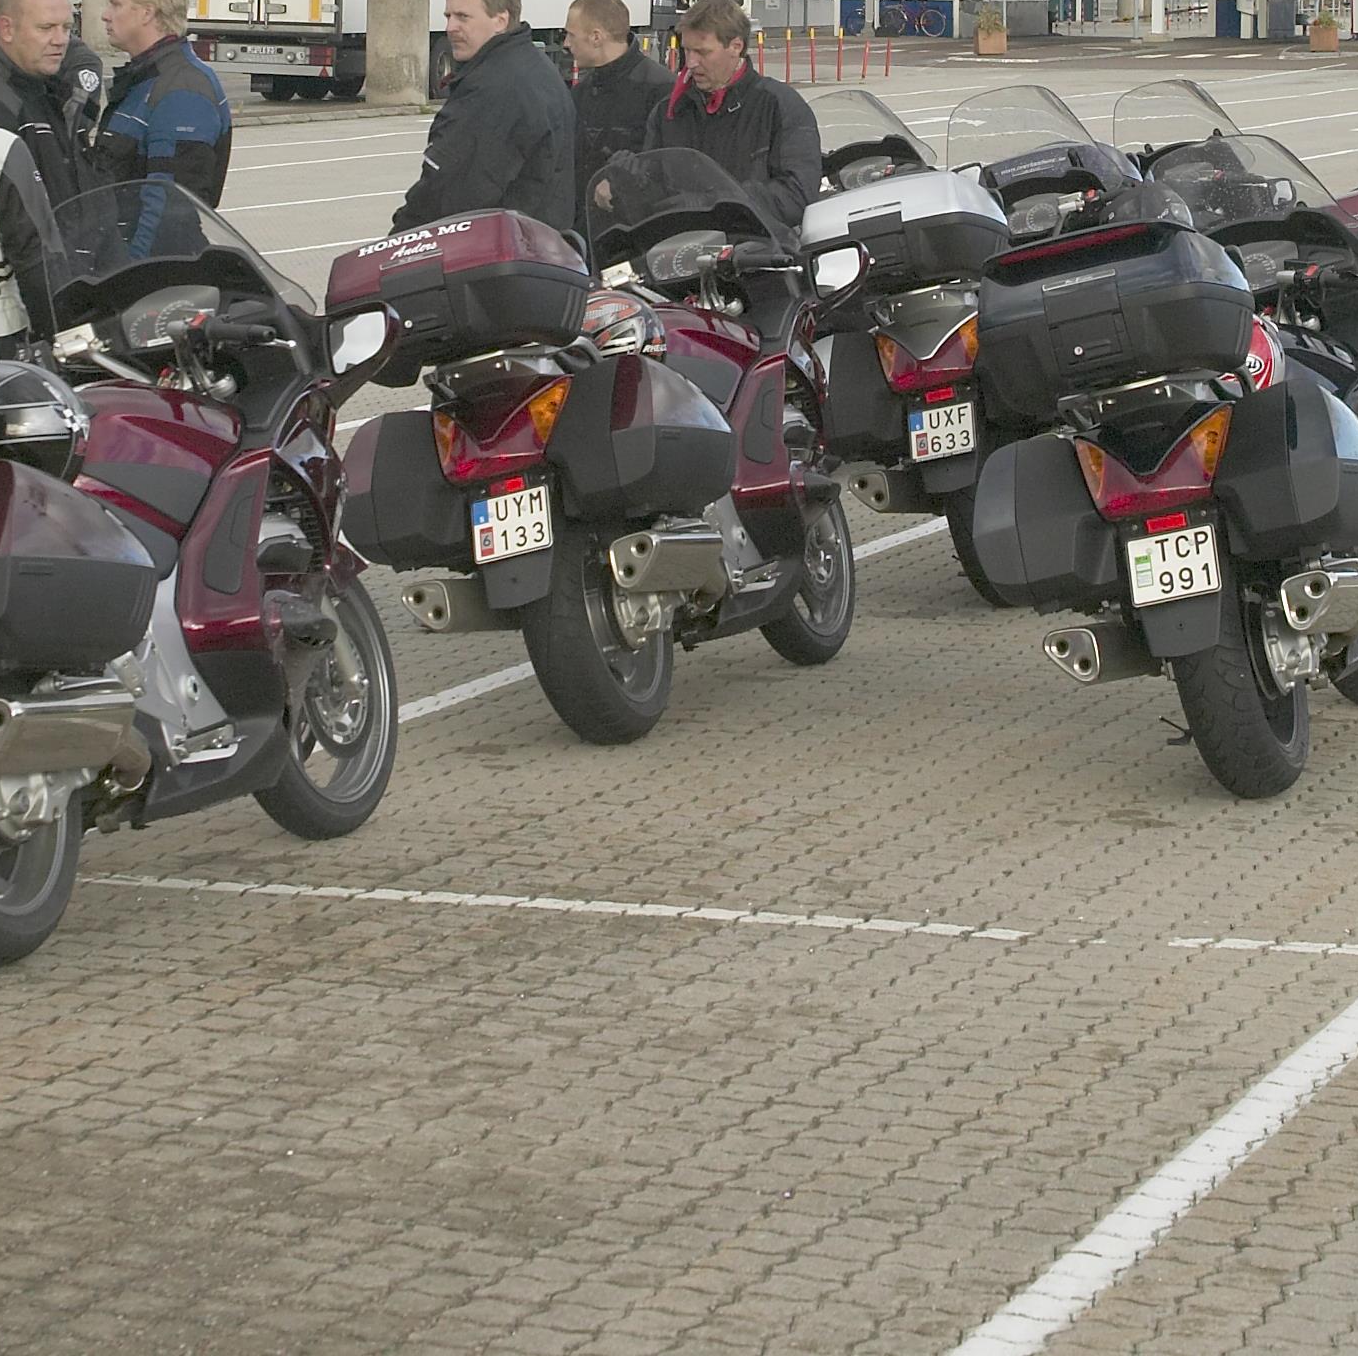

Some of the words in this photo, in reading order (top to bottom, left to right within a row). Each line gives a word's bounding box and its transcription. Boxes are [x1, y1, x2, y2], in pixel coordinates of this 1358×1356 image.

[357, 229, 433, 258] HONDA
[437, 220, 472, 237] MC
[389, 240, 438, 261] Anders
[929, 405, 968, 429] UXF
[930, 429, 971, 453] 633
[495, 490, 543, 522] UYM
[500, 521, 545, 551] 133
[1154, 530, 1209, 562] TCP
[1159, 562, 1212, 594] 991
